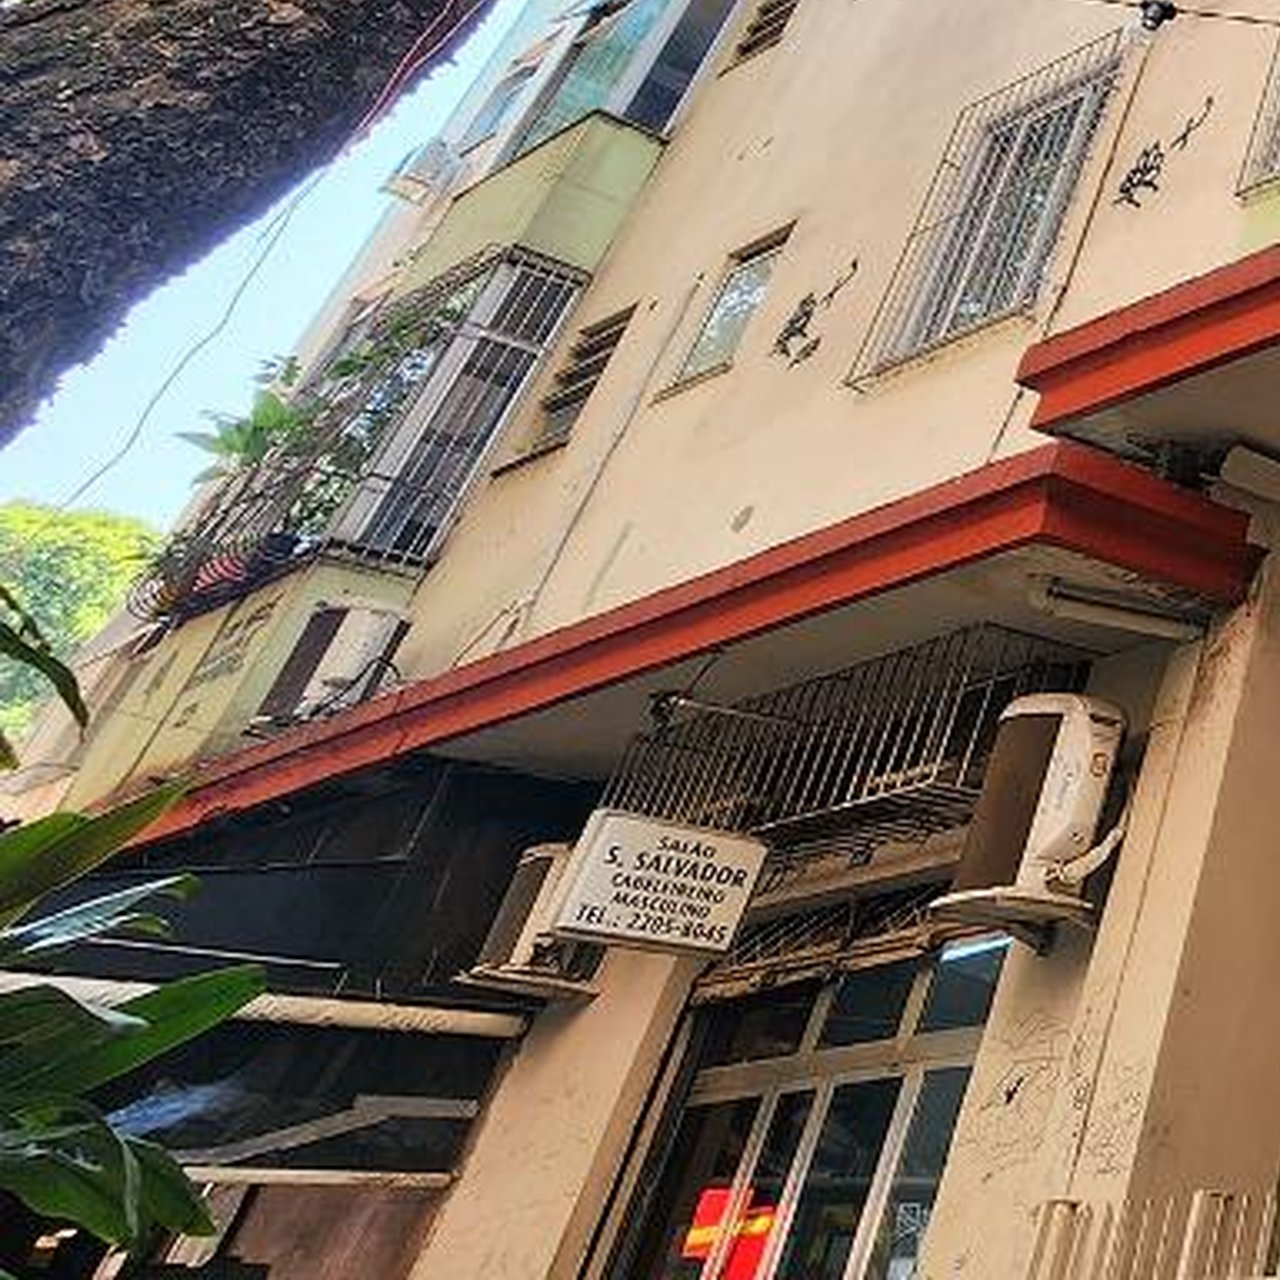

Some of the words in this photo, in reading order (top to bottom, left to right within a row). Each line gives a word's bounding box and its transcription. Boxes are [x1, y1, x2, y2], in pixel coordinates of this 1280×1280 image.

[603, 845, 623, 868] S.
[633, 851, 748, 887] SALVADOR
[611, 872, 725, 904] CABELEIREIRO
[611, 891, 711, 920] MASCULINO
